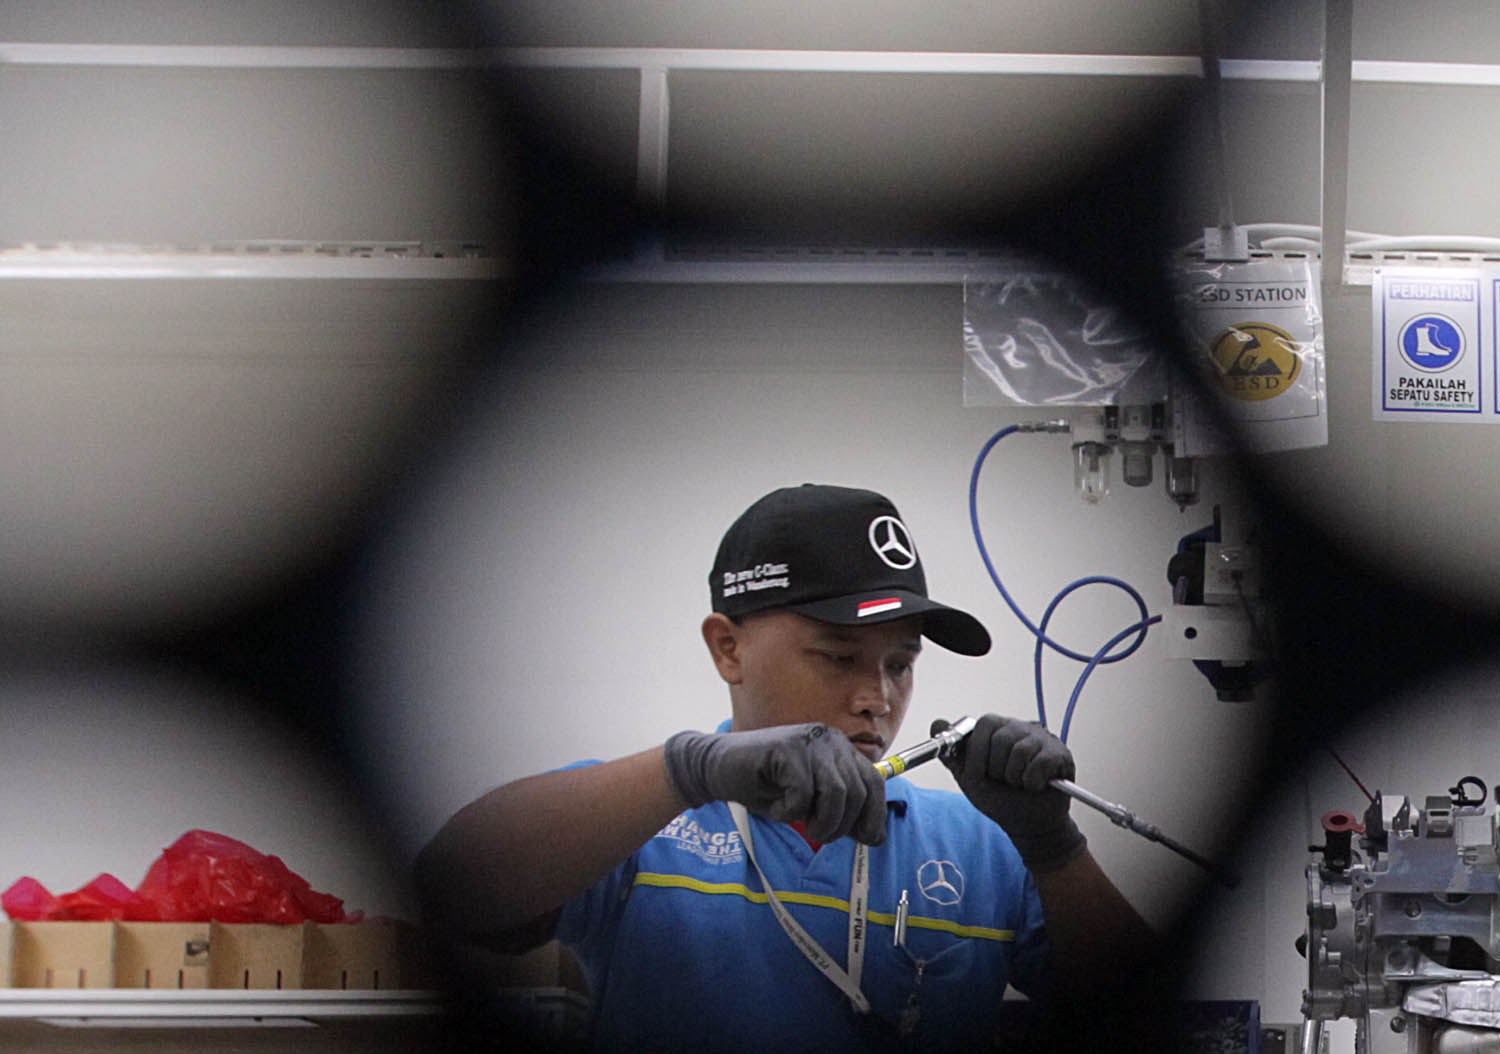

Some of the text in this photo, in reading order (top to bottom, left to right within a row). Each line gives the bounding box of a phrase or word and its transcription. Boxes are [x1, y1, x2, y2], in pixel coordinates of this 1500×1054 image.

[1235, 287, 1306, 302] STATION
[1391, 284, 1473, 300] PERHATIAN
[1234, 376, 1280, 391] ESD
[1399, 377, 1466, 390] PAKAILAH
[1390, 389, 1474, 403] SEPATU SAFETY
